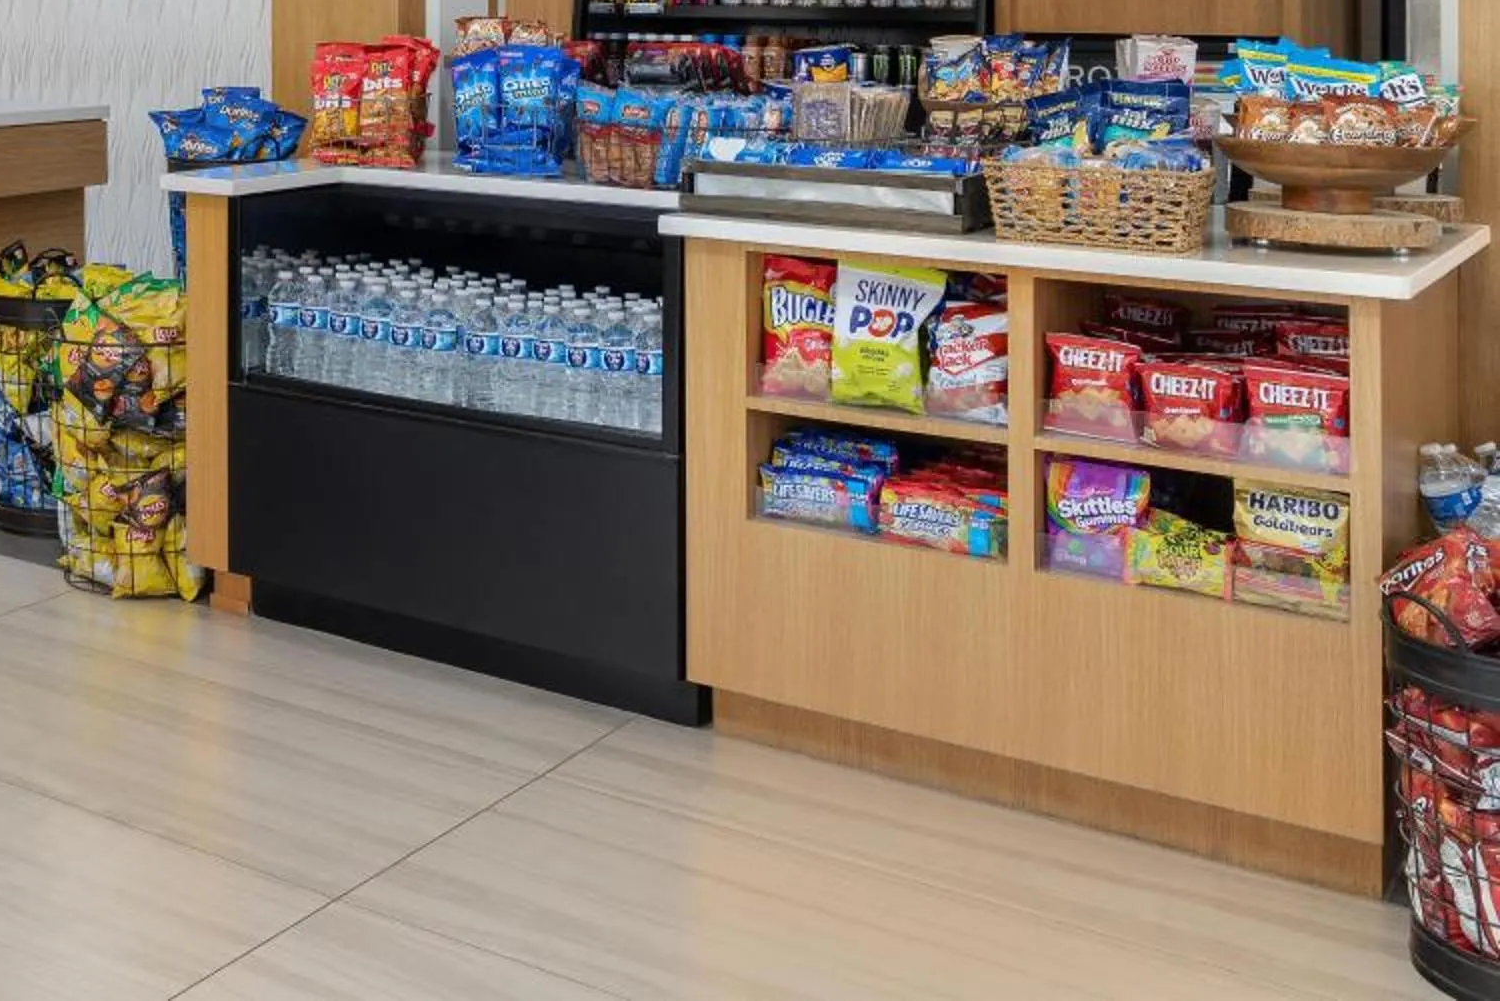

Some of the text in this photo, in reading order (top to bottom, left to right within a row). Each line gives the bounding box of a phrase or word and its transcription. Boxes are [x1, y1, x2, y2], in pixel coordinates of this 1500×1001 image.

[771, 286, 836, 328] BUGLE
[850, 305, 915, 338] POP
[1060, 345, 1125, 373] CHEEZ-IT
[1151, 372, 1217, 400] CHEEZ-IT
[1259, 381, 1332, 410] CHEEZ-IT
[1057, 496, 1137, 519] Skittles
[1249, 491, 1340, 520] HARIBO
[1075, 513, 1137, 529] Gummies
[1252, 513, 1334, 538] Goldbears
